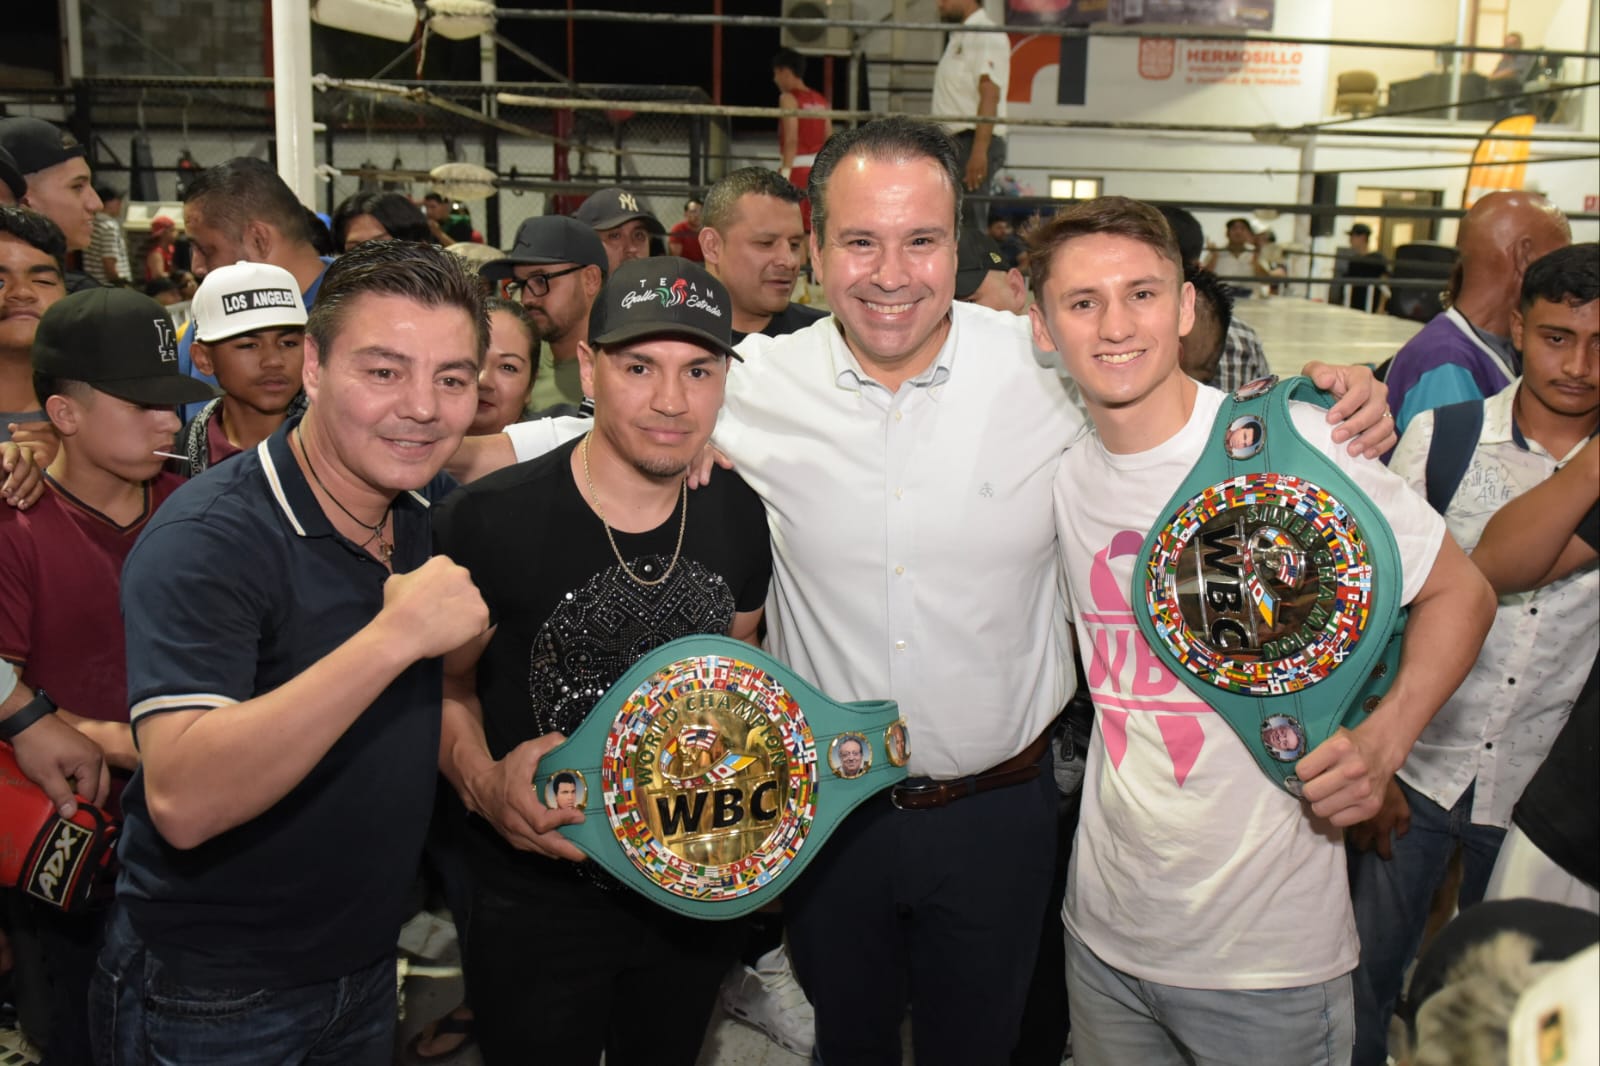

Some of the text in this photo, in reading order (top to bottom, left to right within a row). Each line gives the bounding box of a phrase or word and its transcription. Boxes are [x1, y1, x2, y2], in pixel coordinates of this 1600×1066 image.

[1186, 48, 1304, 65] HERMOSILLO
[223, 289, 296, 313] LOS ANGELES
[621, 288, 722, 318] Gallo Estrada
[1202, 523, 1251, 651] WBC
[1247, 504, 1337, 661] SILVER CHAMPION
[635, 693, 788, 787] WORLD CHAMPION
[655, 779, 778, 837] WBC
[38, 825, 78, 900] ADX
